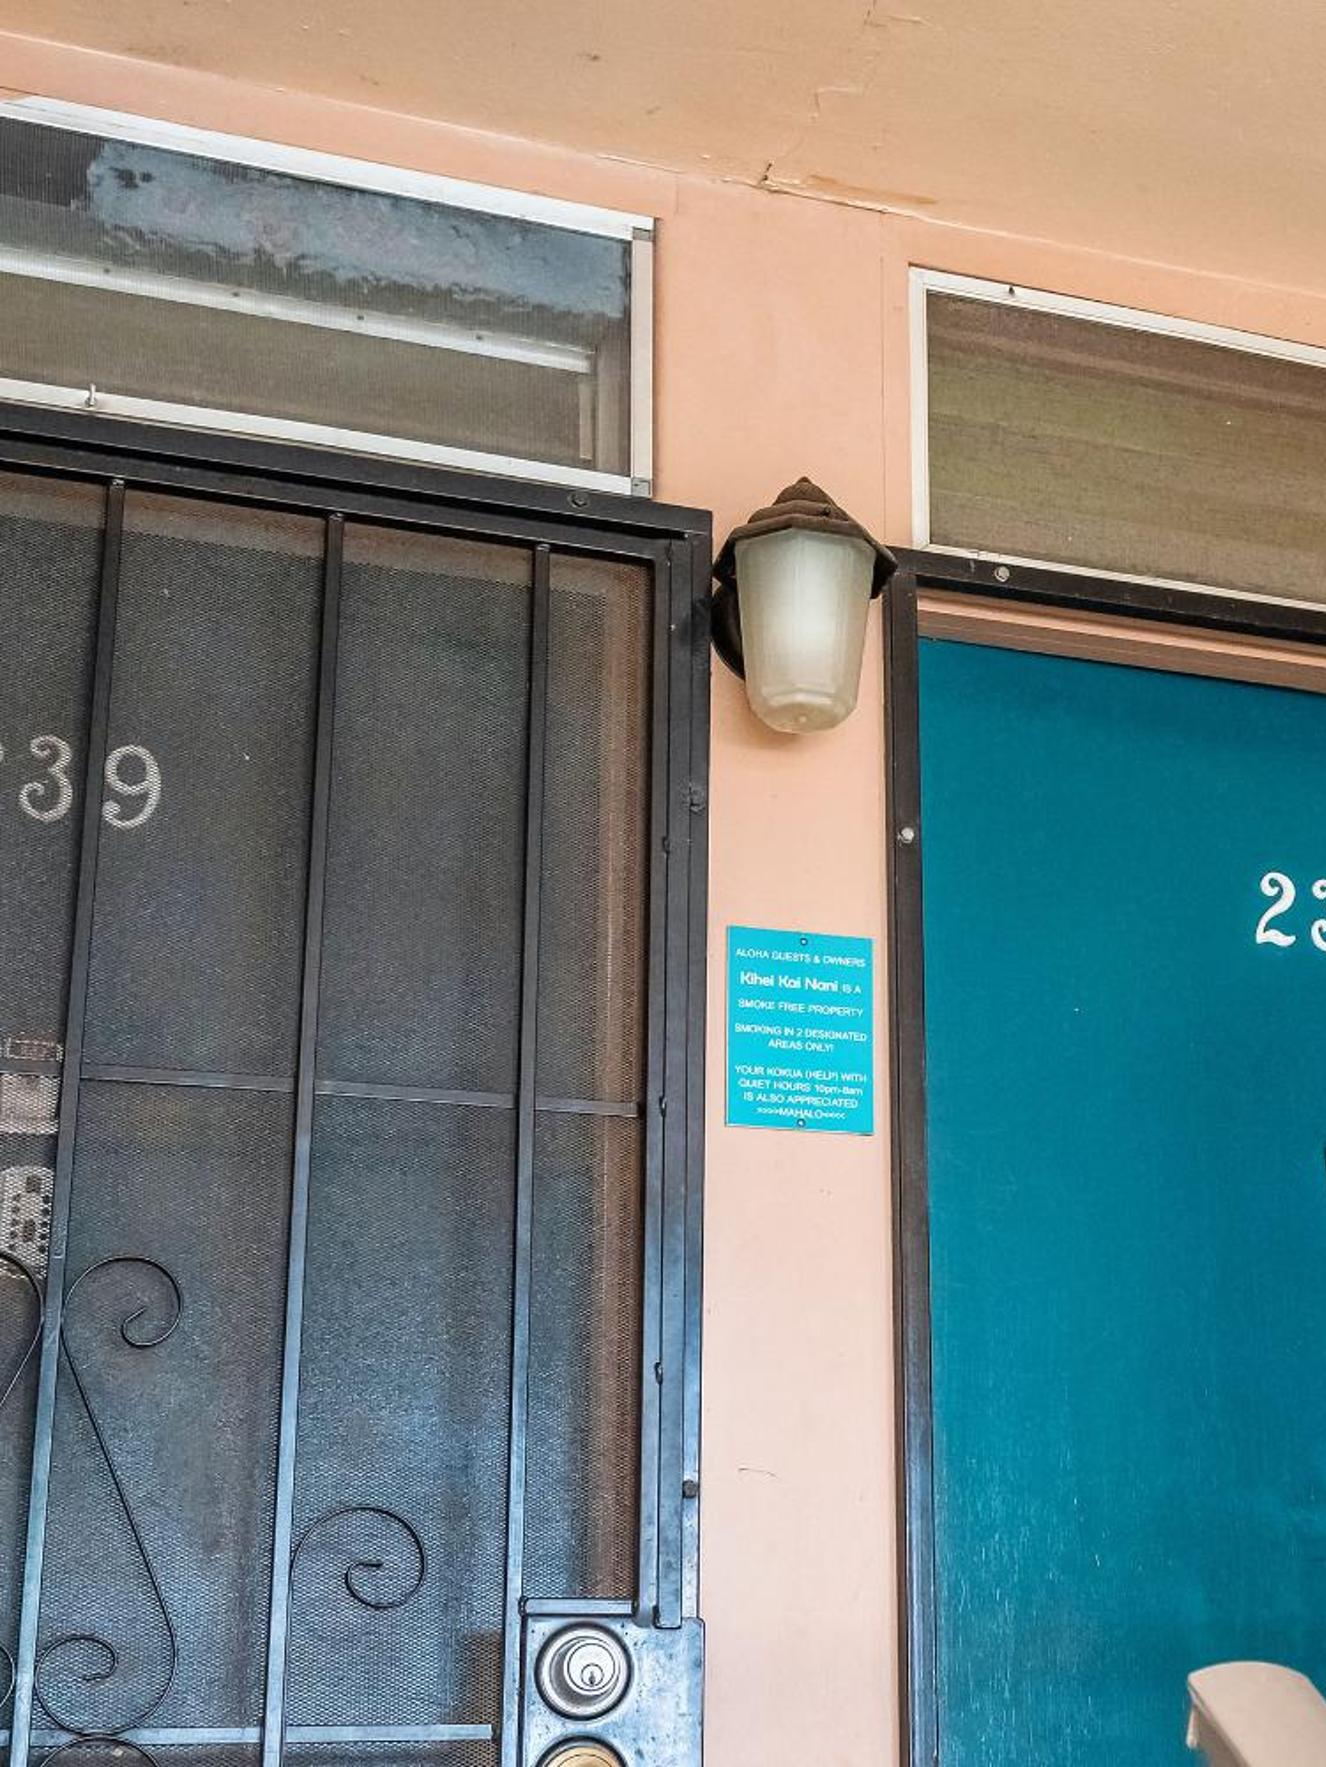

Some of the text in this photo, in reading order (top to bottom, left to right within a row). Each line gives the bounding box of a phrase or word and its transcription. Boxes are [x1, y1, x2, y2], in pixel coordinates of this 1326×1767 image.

[0, 730, 162, 831] 39
[736, 948, 866, 968] ALOHA GUESTS & OWNERS
[740, 971, 862, 994] Kihei Kai Nani IS A
[738, 998, 863, 1017] SMOKE FREE PROPERTY
[735, 1022, 867, 1042] SMOKING IN 2 DESIGNATED
[768, 1038, 802, 1050] AREAS
[735, 1065, 867, 1083] YOUR KOKUA (HELP) WITH
[738, 1078, 863, 1096] QUIET HOURS 10pm-8am
[743, 1091, 858, 1109] IS ALSO APPRECIATED
